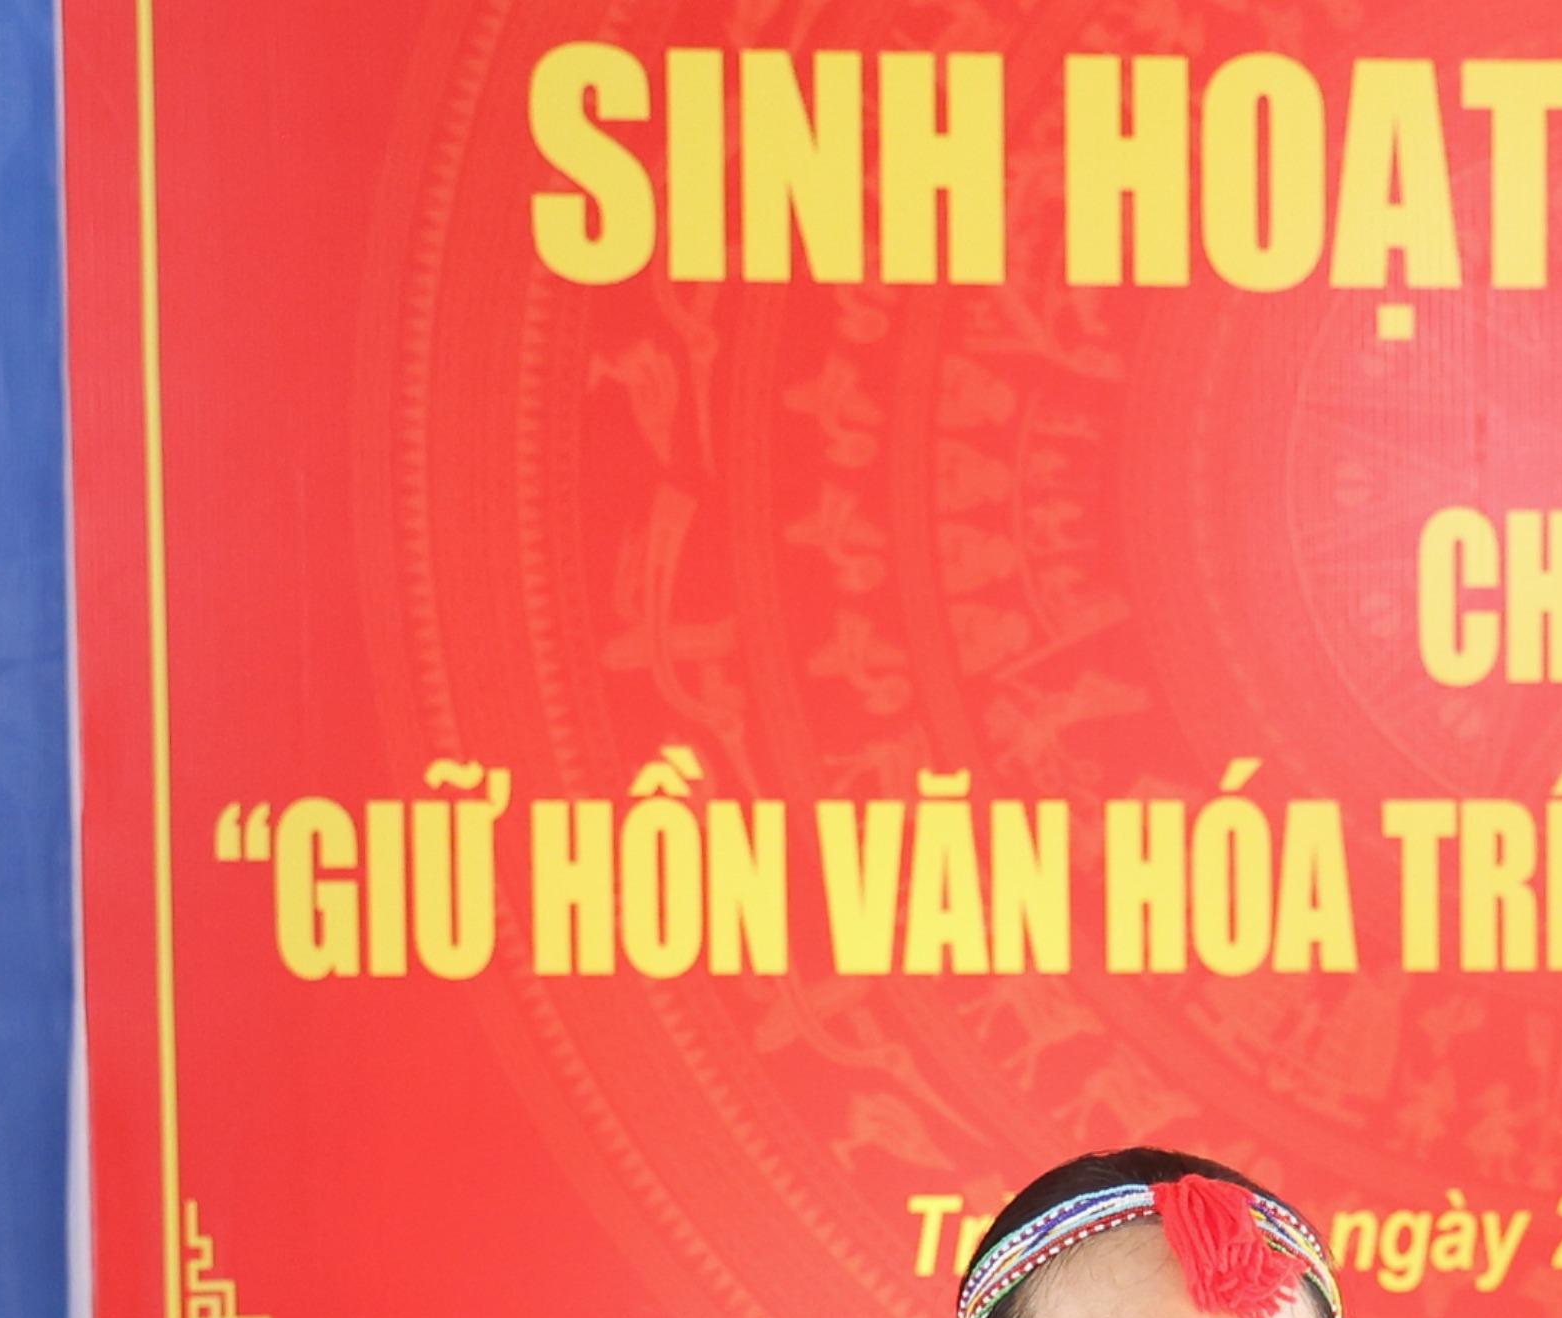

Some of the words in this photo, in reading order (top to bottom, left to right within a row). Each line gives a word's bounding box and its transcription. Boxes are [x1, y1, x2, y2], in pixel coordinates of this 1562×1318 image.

[528, 41, 1006, 286] SINH
[215, 758, 512, 981] “GIỮ
[530, 744, 790, 980] HỒN
[815, 768, 1072, 977] VĂN
[1103, 756, 1359, 978] HÓA
[1330, 1188, 1532, 1293] ngày
